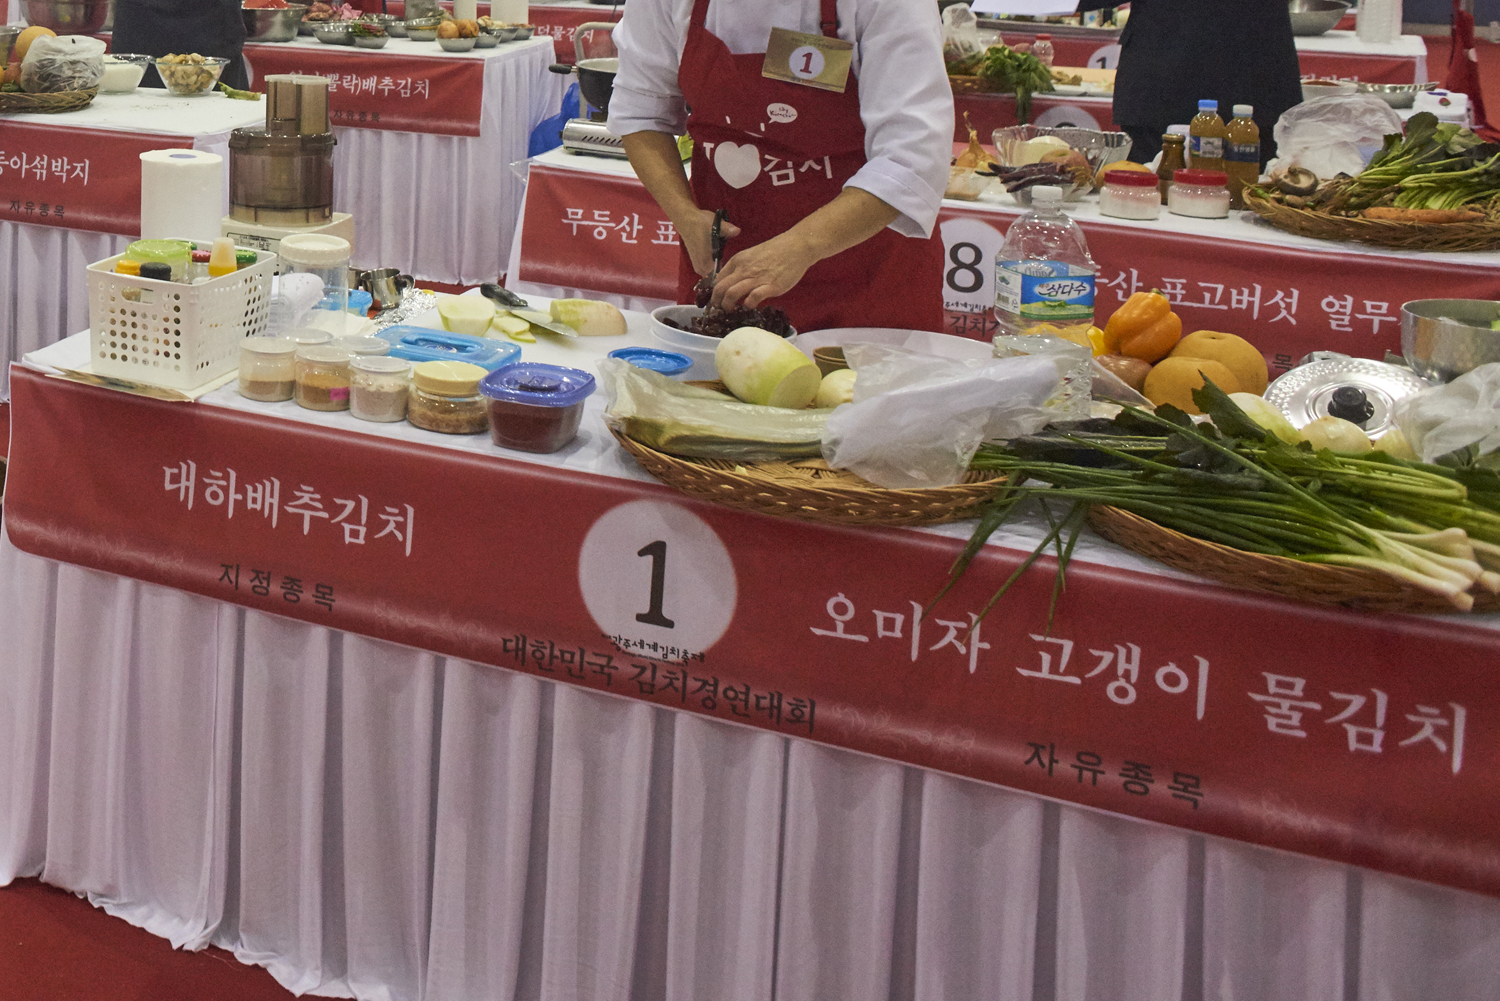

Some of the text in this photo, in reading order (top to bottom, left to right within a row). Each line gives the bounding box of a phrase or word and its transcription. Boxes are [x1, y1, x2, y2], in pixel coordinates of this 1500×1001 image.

[799, 52, 813, 74] 1
[9, 200, 65, 219] 자유종목
[561, 208, 643, 244] 무등산
[946, 241, 984, 293] 8
[1047, 282, 1087, 297] 삼다수
[1161, 277, 1299, 325] 표고버섯
[162, 459, 415, 557] 대하배추김치
[218, 563, 336, 612] 지정종목
[635, 540, 675, 629] 1
[501, 633, 816, 734] 대한민국 김치경연대회
[810, 592, 1467, 776] 오미자 고갱이 물김치
[1024, 741, 1203, 810] 자유종목
